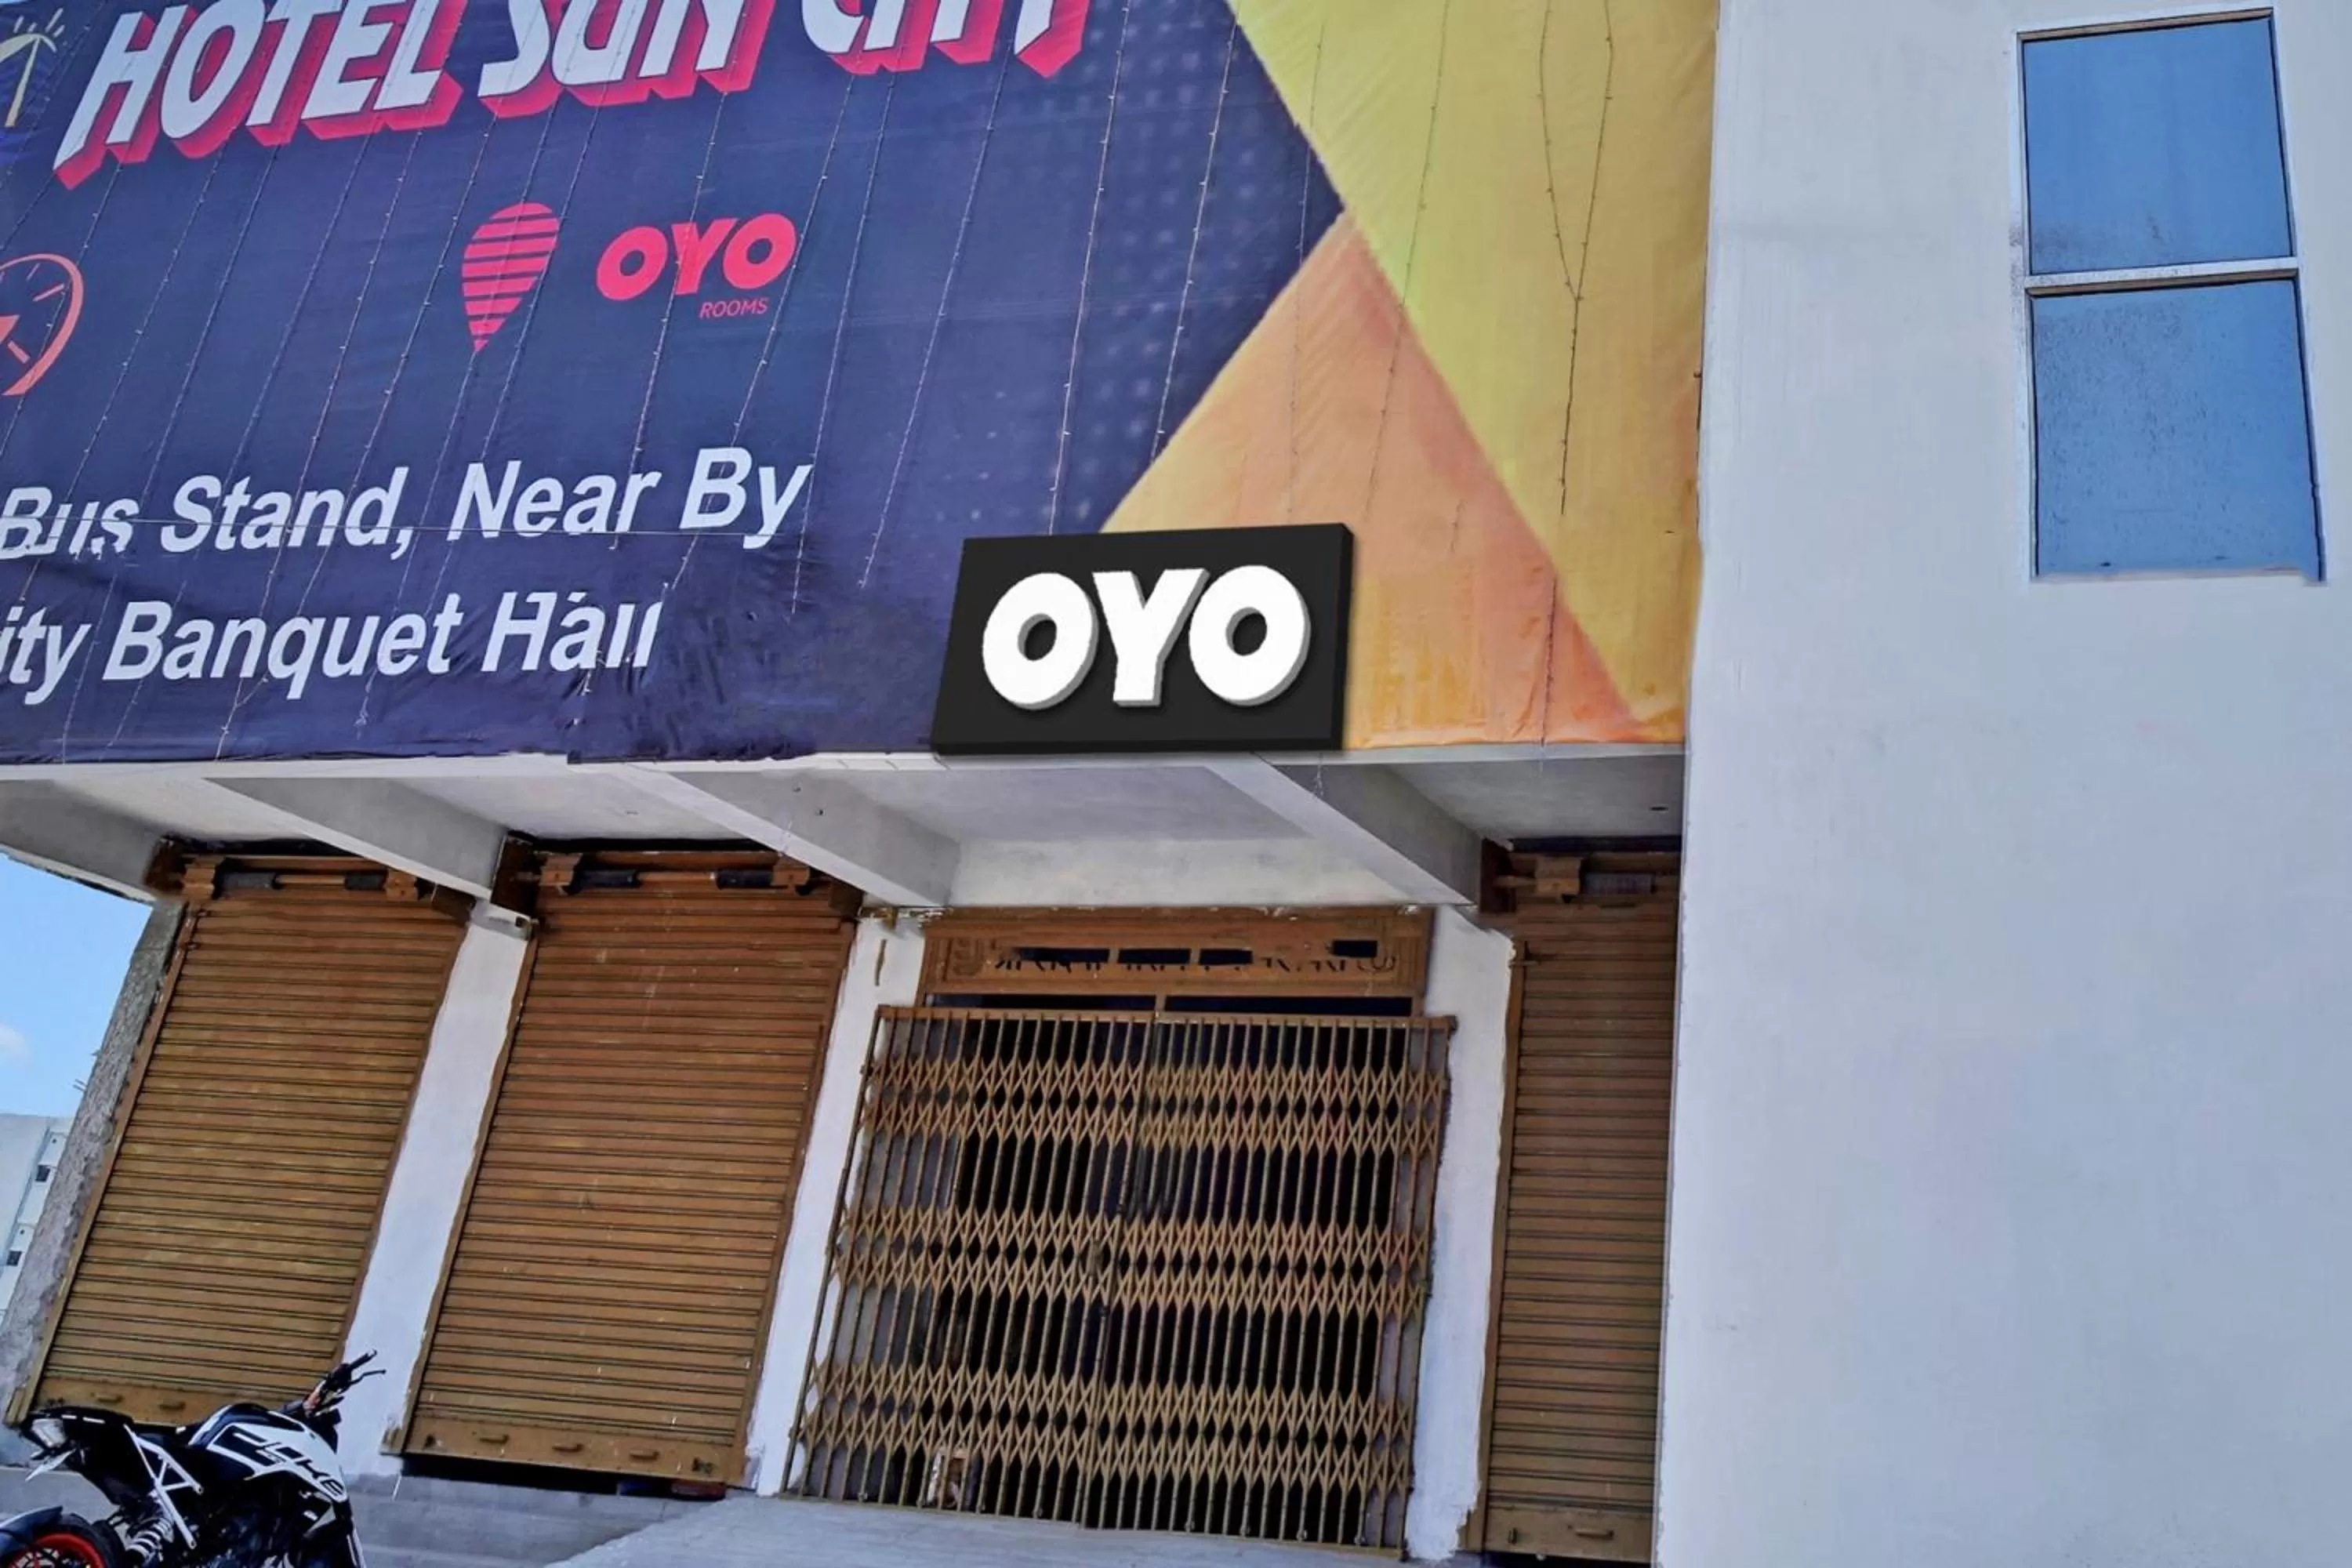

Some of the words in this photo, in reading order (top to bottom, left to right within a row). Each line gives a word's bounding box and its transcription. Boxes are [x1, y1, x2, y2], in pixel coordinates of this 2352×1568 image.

[53, 0, 464, 190] HOTEL
[596, 212, 797, 301] OYO
[699, 298, 769, 319] ROOMS
[0, 487, 140, 561] Bus
[161, 466, 413, 560] Stand,
[447, 459, 662, 541] Near
[679, 447, 813, 549] By
[0, 606, 92, 705] ity
[102, 593, 463, 699] Banquet
[481, 592, 662, 672] Hall
[982, 564, 1312, 710] OYO
